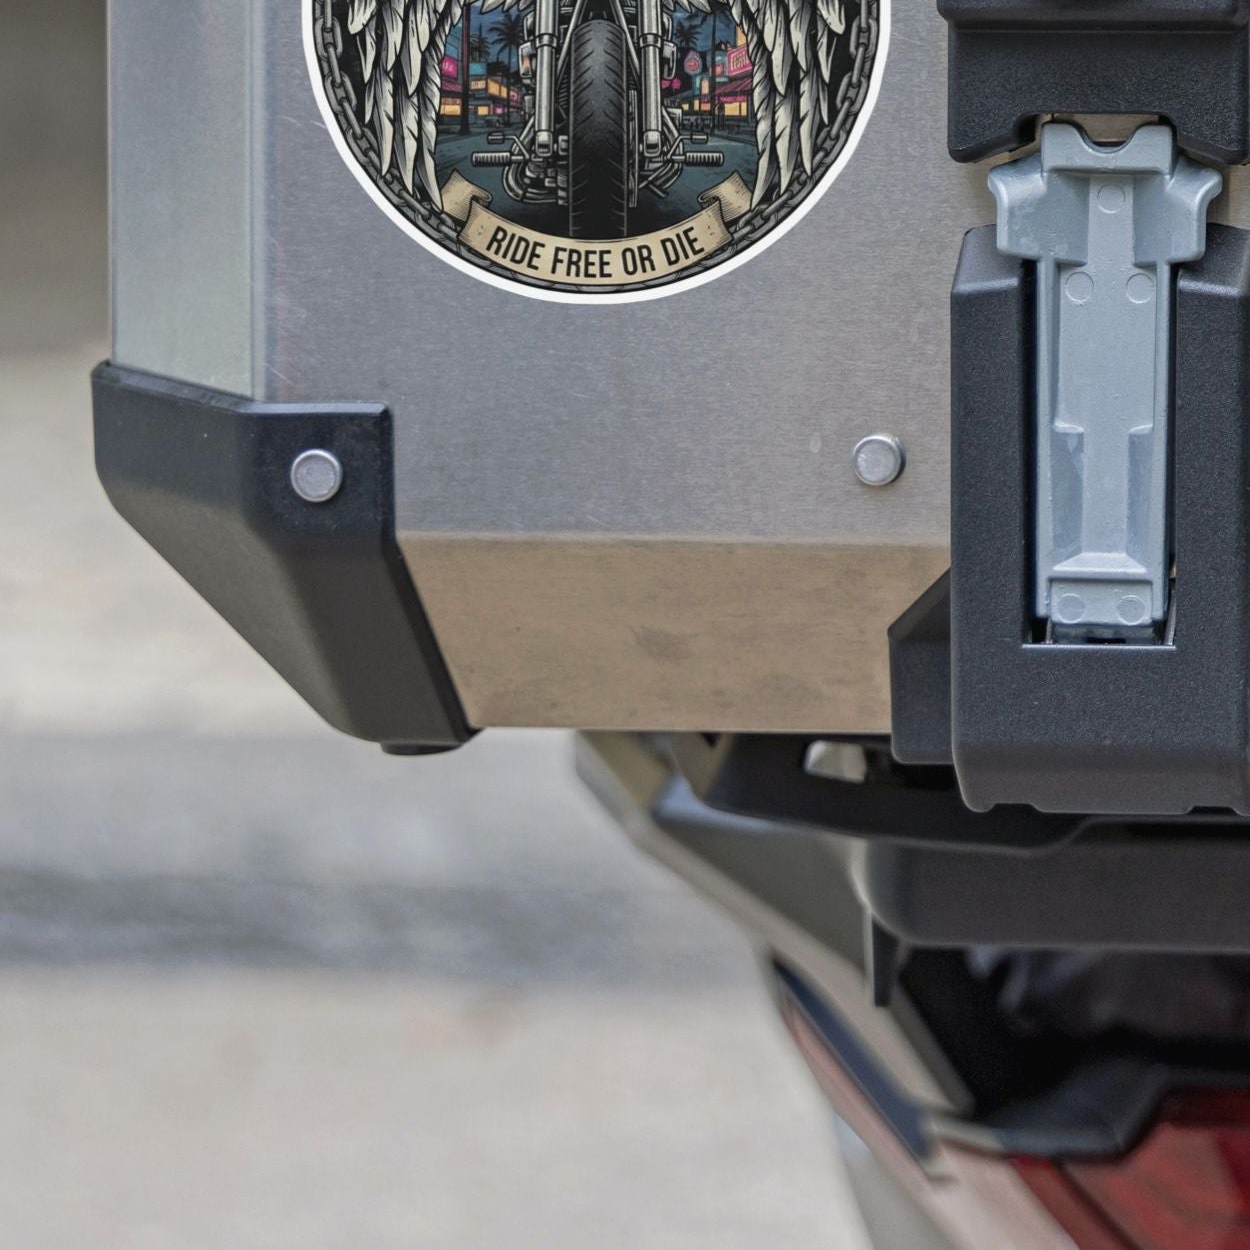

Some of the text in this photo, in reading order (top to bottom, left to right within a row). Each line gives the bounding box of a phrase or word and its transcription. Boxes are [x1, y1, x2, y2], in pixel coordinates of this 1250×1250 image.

[486, 225, 704, 278] RIDE FREE OR DIE
